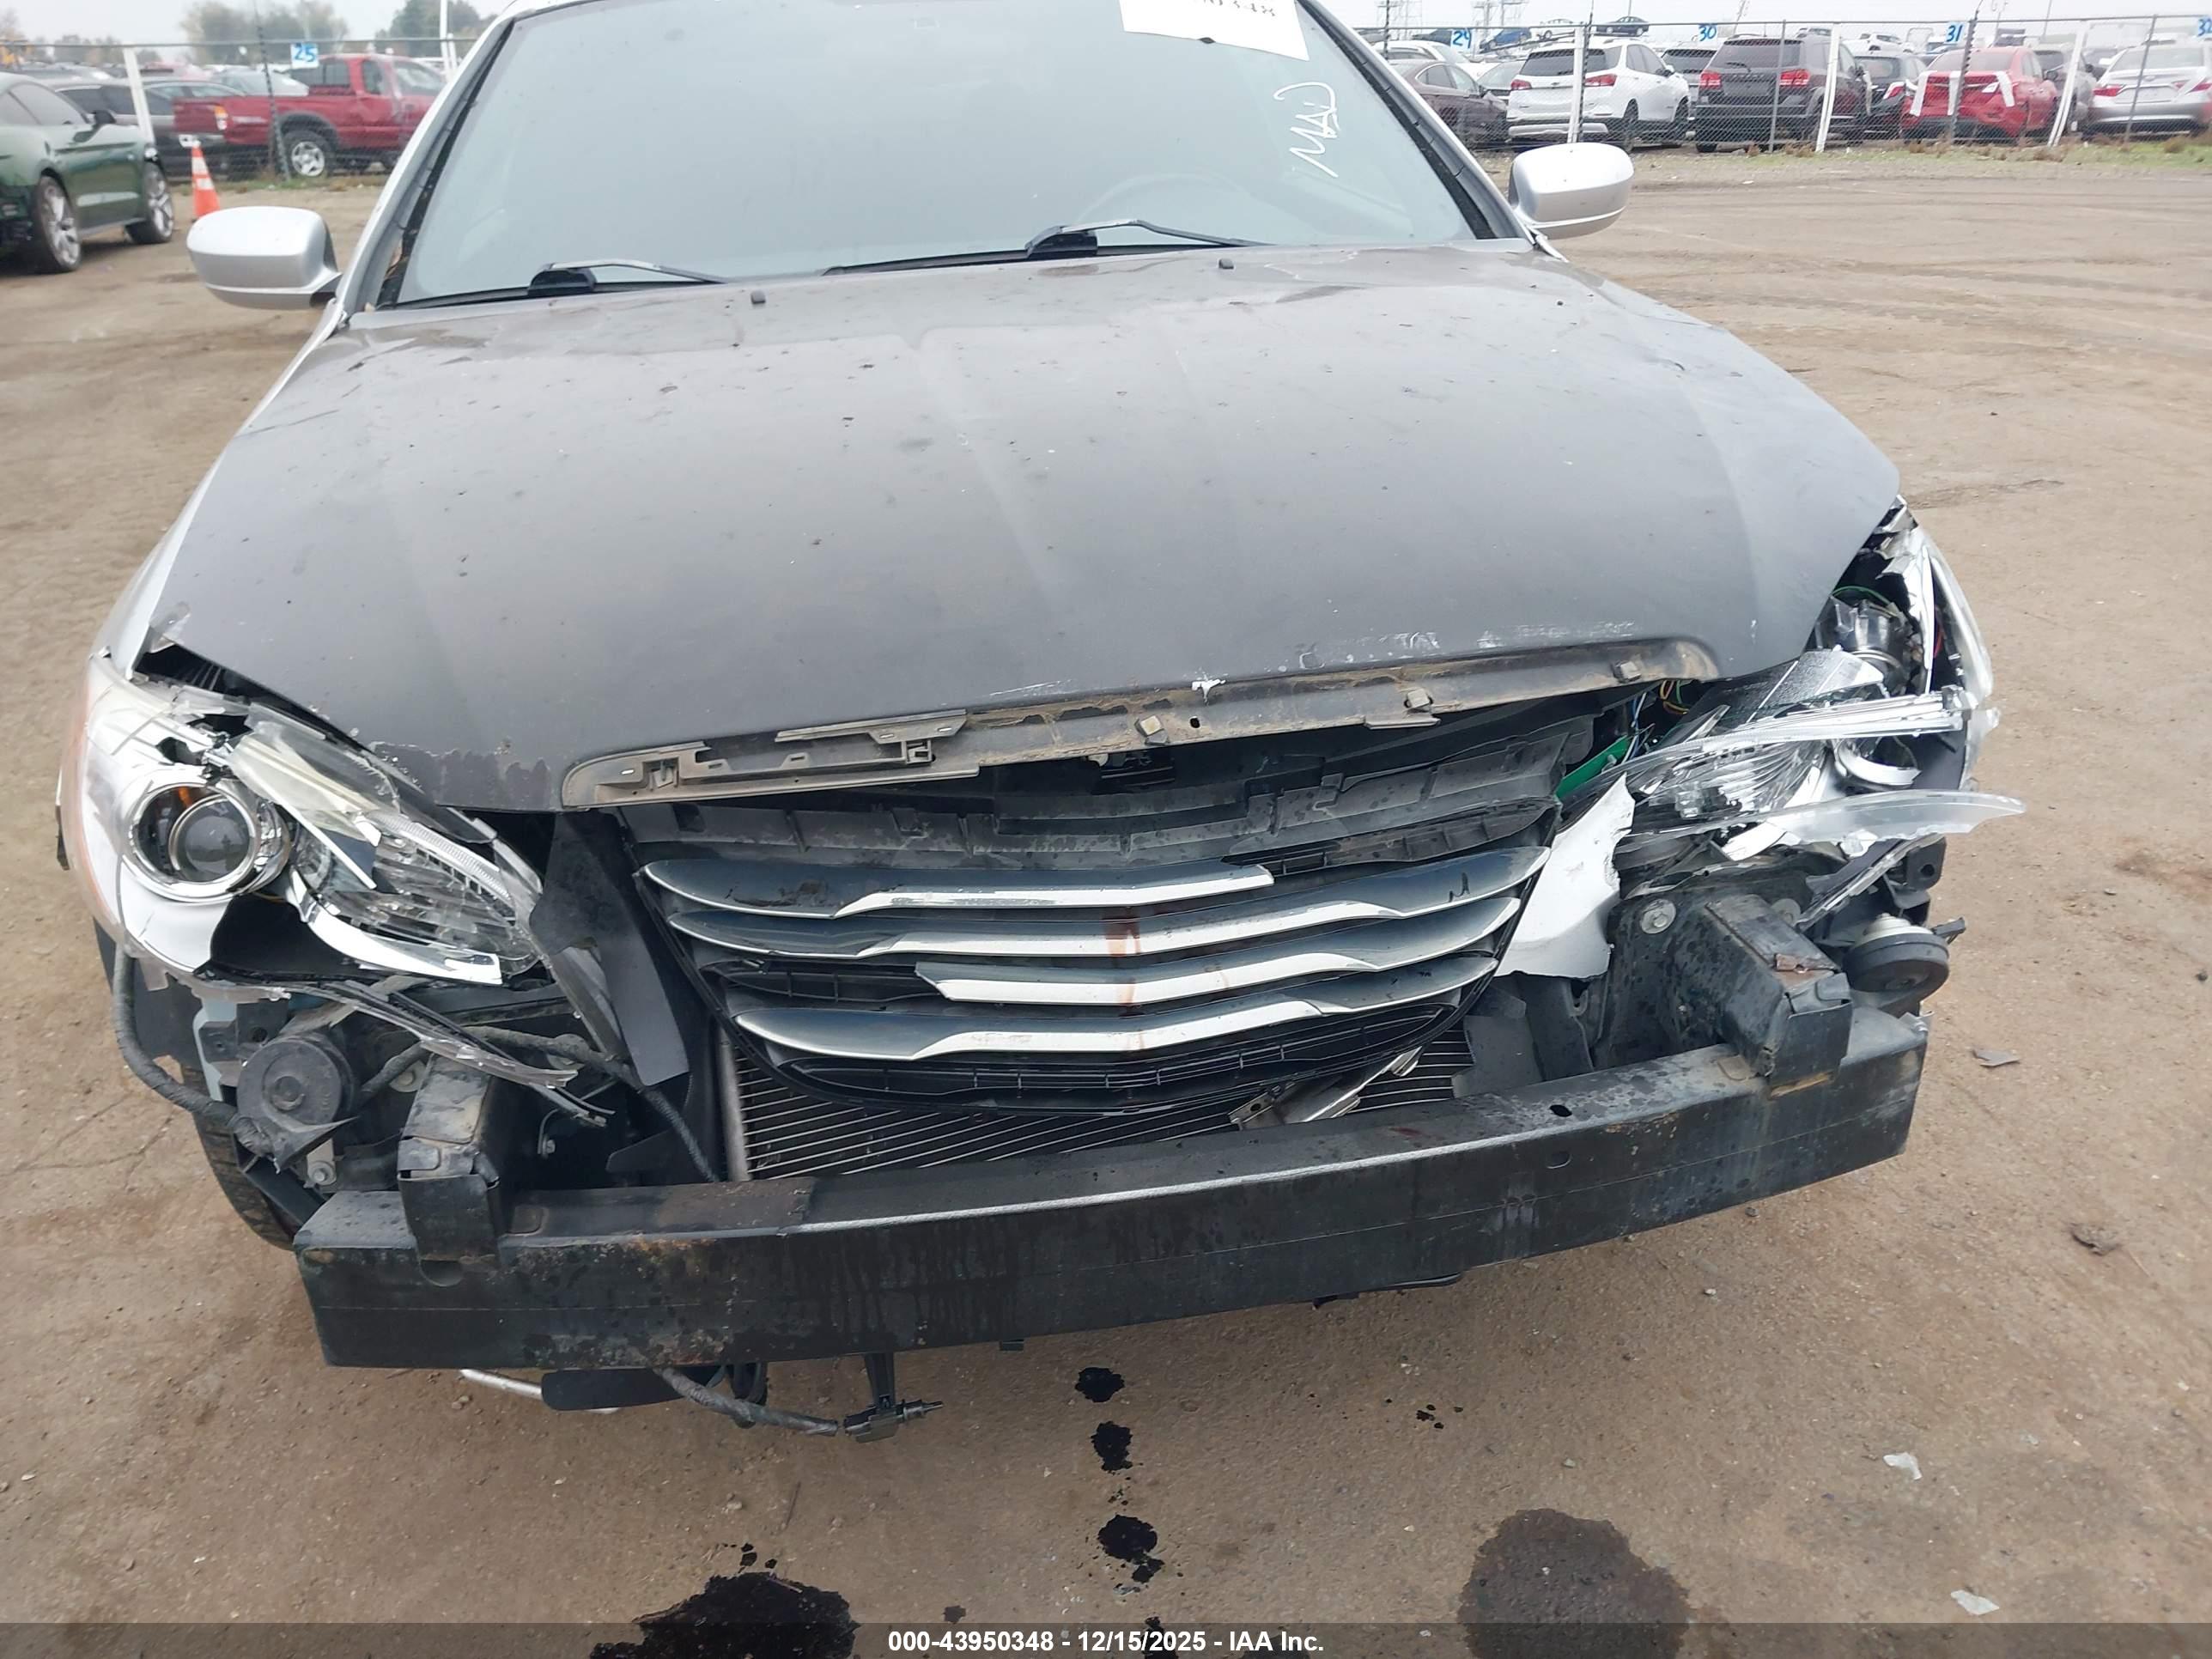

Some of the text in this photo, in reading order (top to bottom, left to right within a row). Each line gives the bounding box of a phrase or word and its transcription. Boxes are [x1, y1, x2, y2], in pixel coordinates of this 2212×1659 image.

[1698, 23, 1717, 42] 30
[1946, 24, 1963, 42] 31
[294, 42, 316, 63] 25
